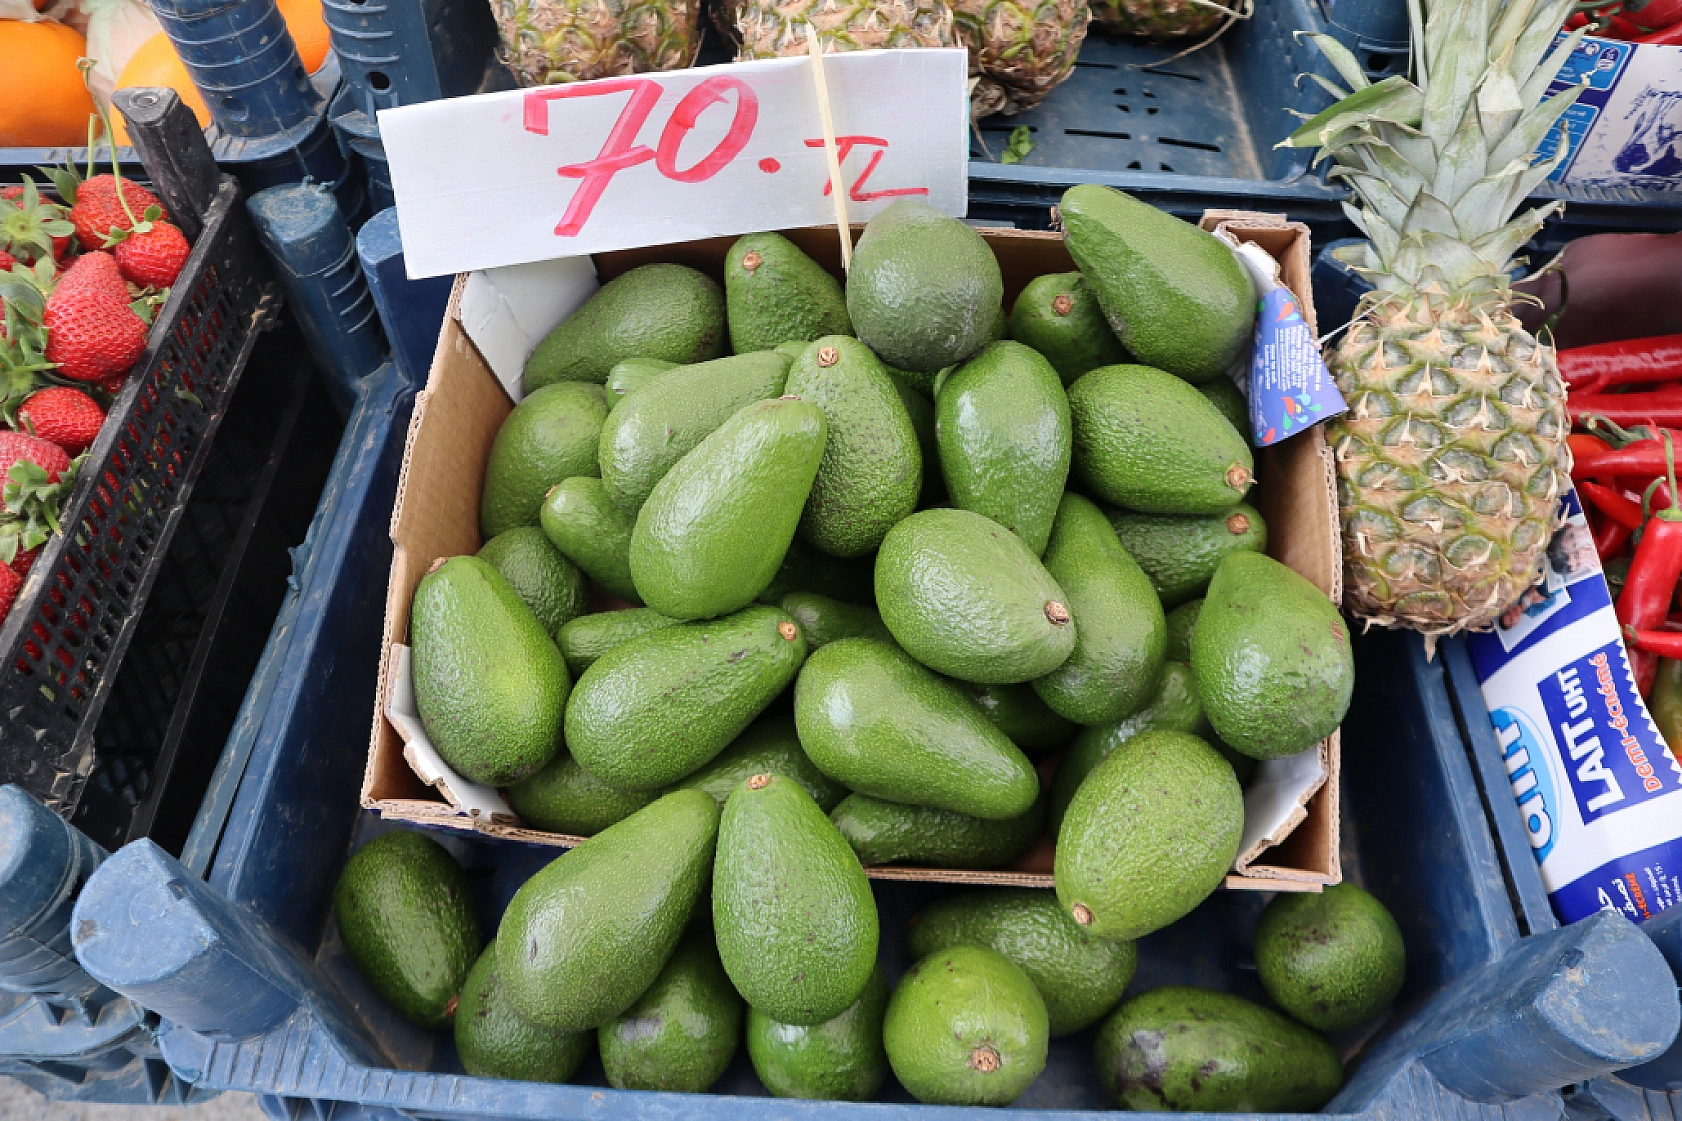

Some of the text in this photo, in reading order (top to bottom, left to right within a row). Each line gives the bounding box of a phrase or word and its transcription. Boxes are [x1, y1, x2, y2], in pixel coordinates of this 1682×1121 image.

[803, 135, 930, 202] TL
[1557, 667, 1626, 813] LAIT UHT
